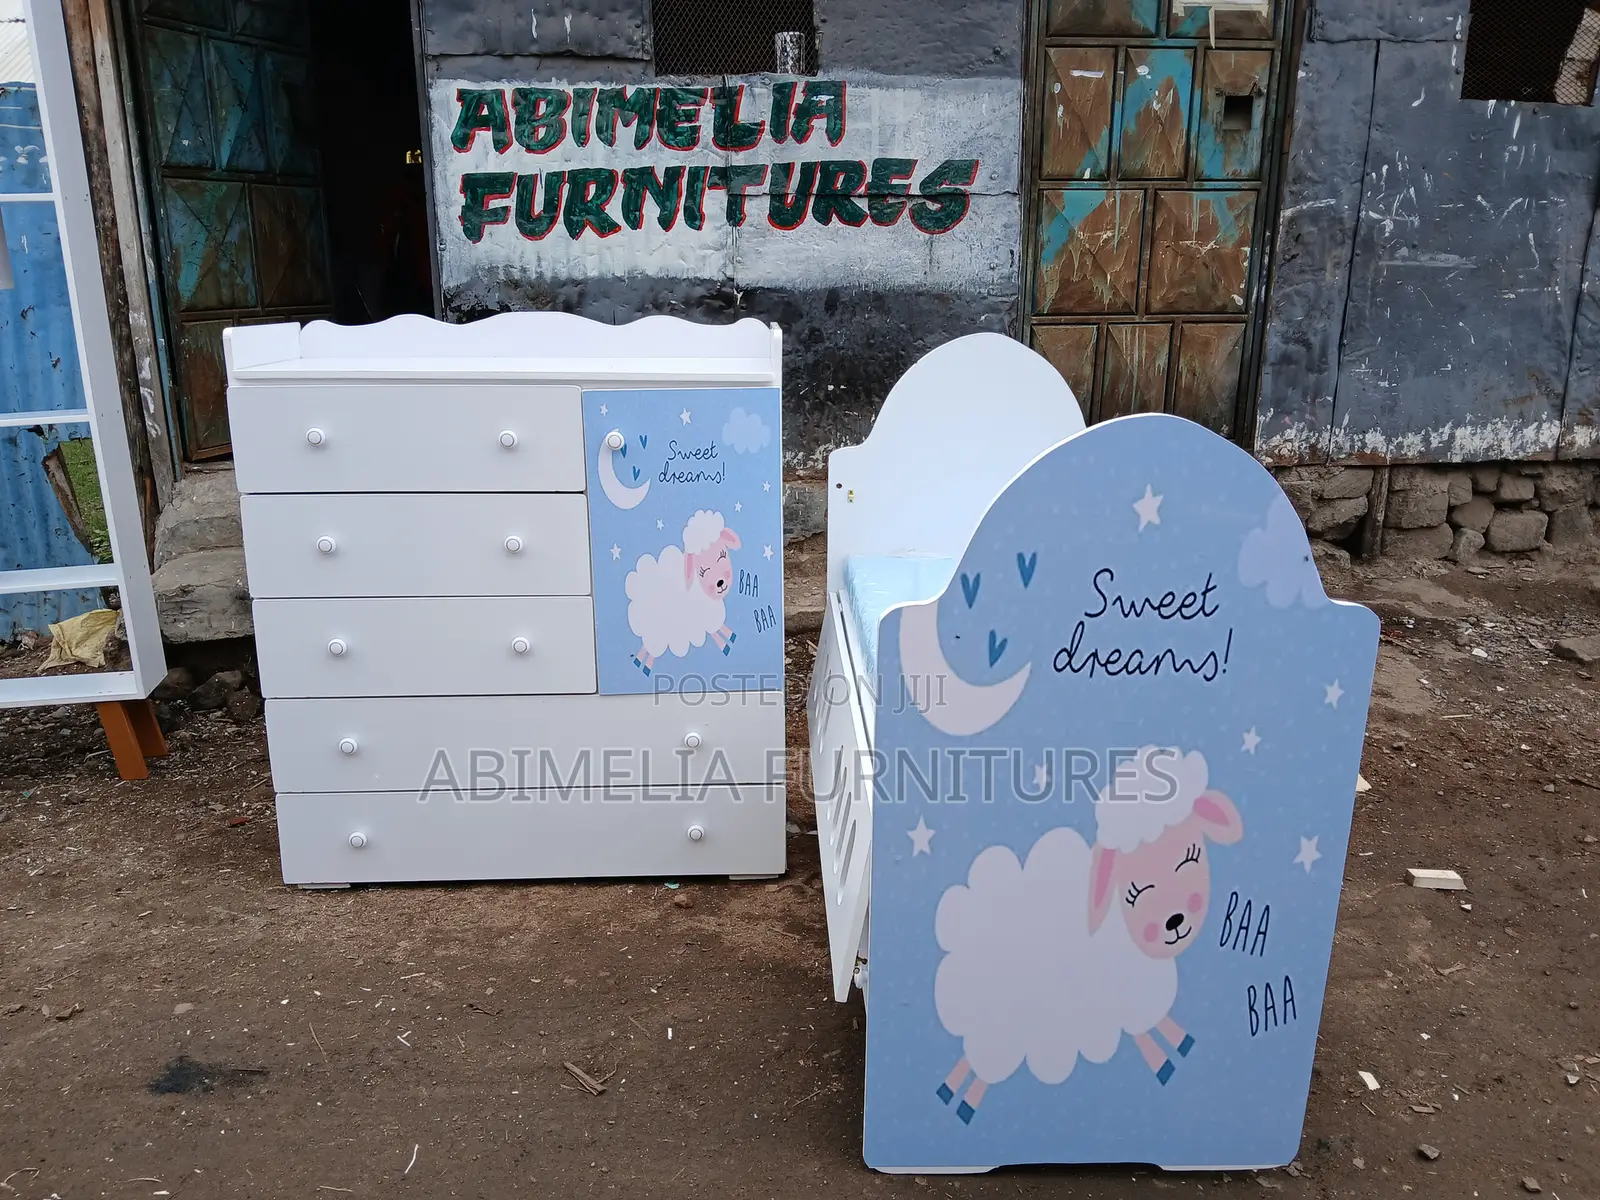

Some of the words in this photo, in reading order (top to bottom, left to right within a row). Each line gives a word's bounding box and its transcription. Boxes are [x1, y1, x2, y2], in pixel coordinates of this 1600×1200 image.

[450, 80, 847, 155] ABIMELIA
[458, 157, 980, 244] FURNITURES
[658, 462, 726, 484] dreams!
[667, 440, 719, 461] Sweet
[739, 569, 759, 598] BAA
[1084, 568, 1220, 620] Sweet
[753, 605, 777, 634] BAA
[1052, 621, 1234, 682] dreams!
[1219, 891, 1271, 957] BAA
[1246, 975, 1298, 1037] BAA
